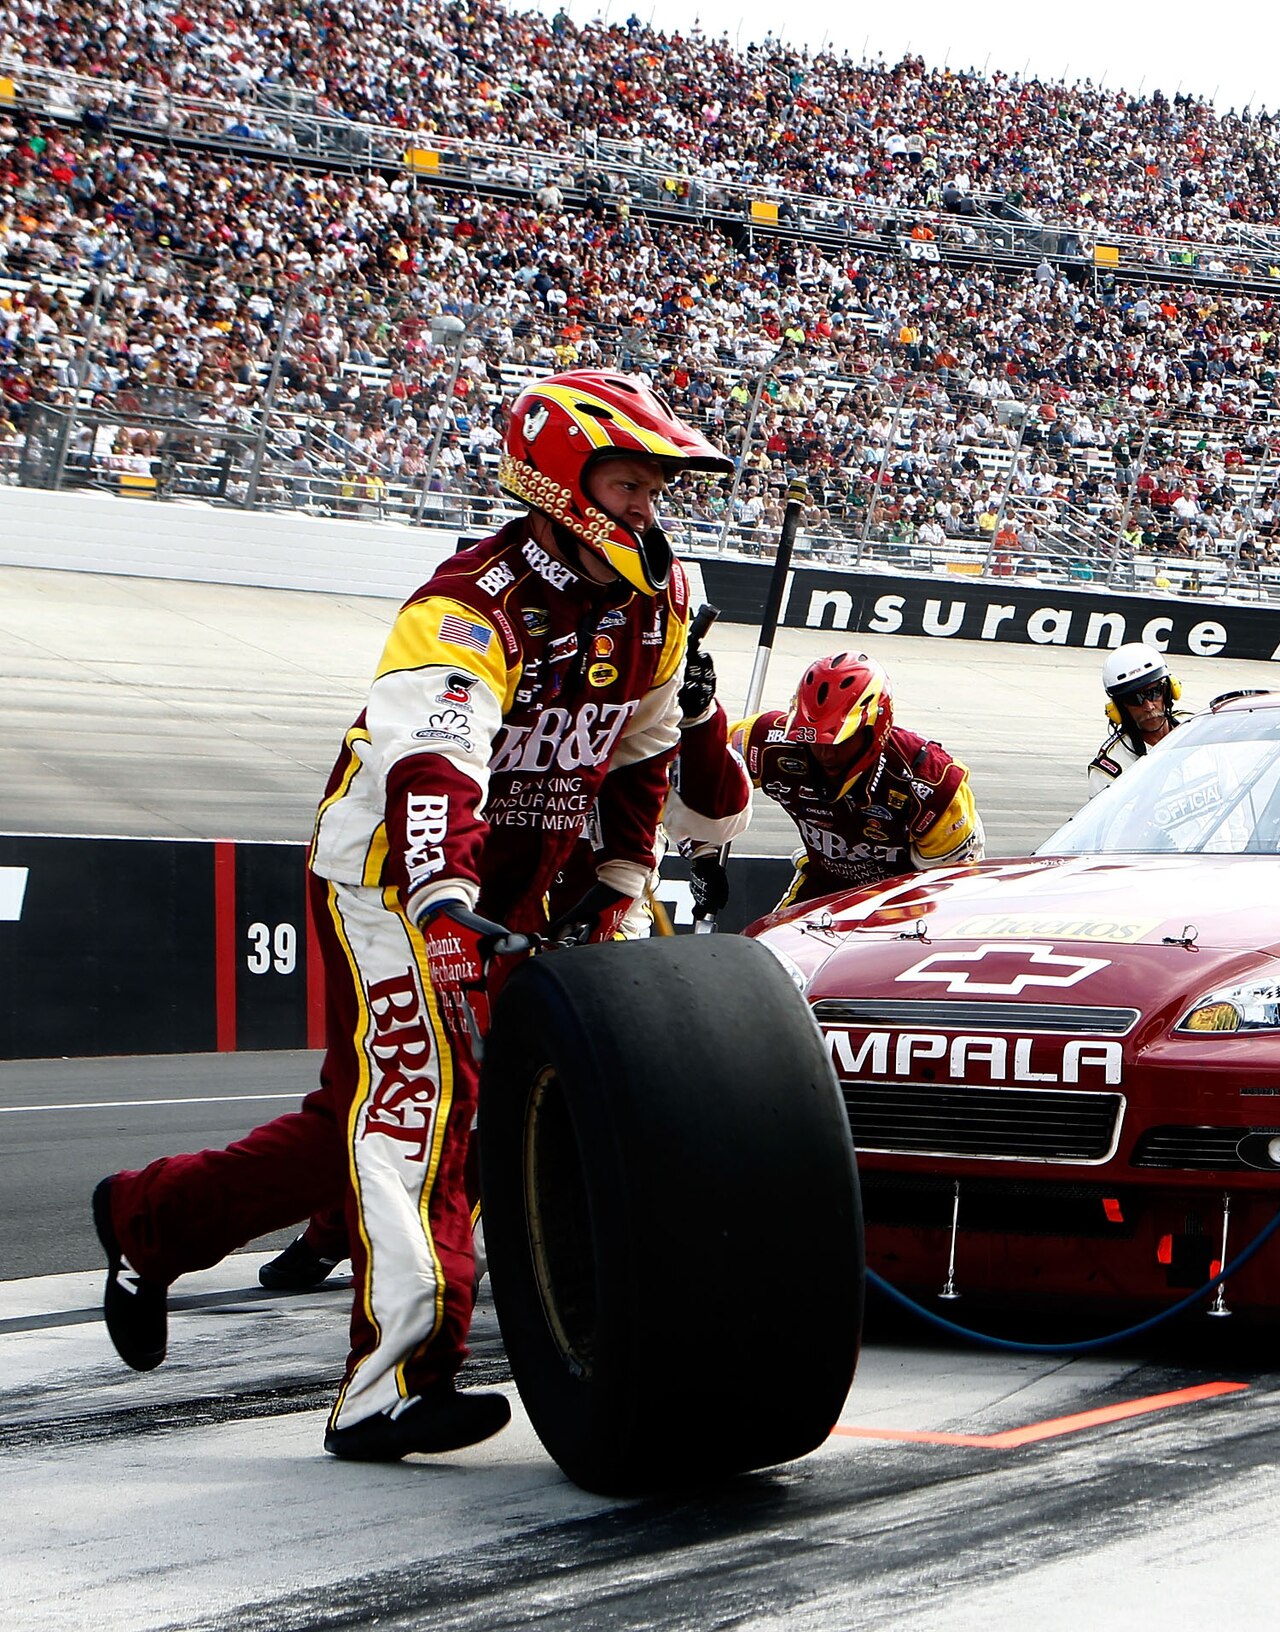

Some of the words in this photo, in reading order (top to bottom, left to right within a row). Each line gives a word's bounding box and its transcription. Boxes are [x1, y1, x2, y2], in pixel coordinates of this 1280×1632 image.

[914, 245, 937, 259] 25
[521, 538, 579, 592] BB&T
[493, 608, 519, 655] SIMPSON
[777, 571, 1227, 656] Insurance
[797, 727, 817, 743] 33
[404, 792, 448, 882] BB&T
[799, 819, 905, 863] BB&T
[246, 922, 297, 975] 39
[956, 917, 1141, 941] Cheerios
[361, 965, 436, 1163] BB&T
